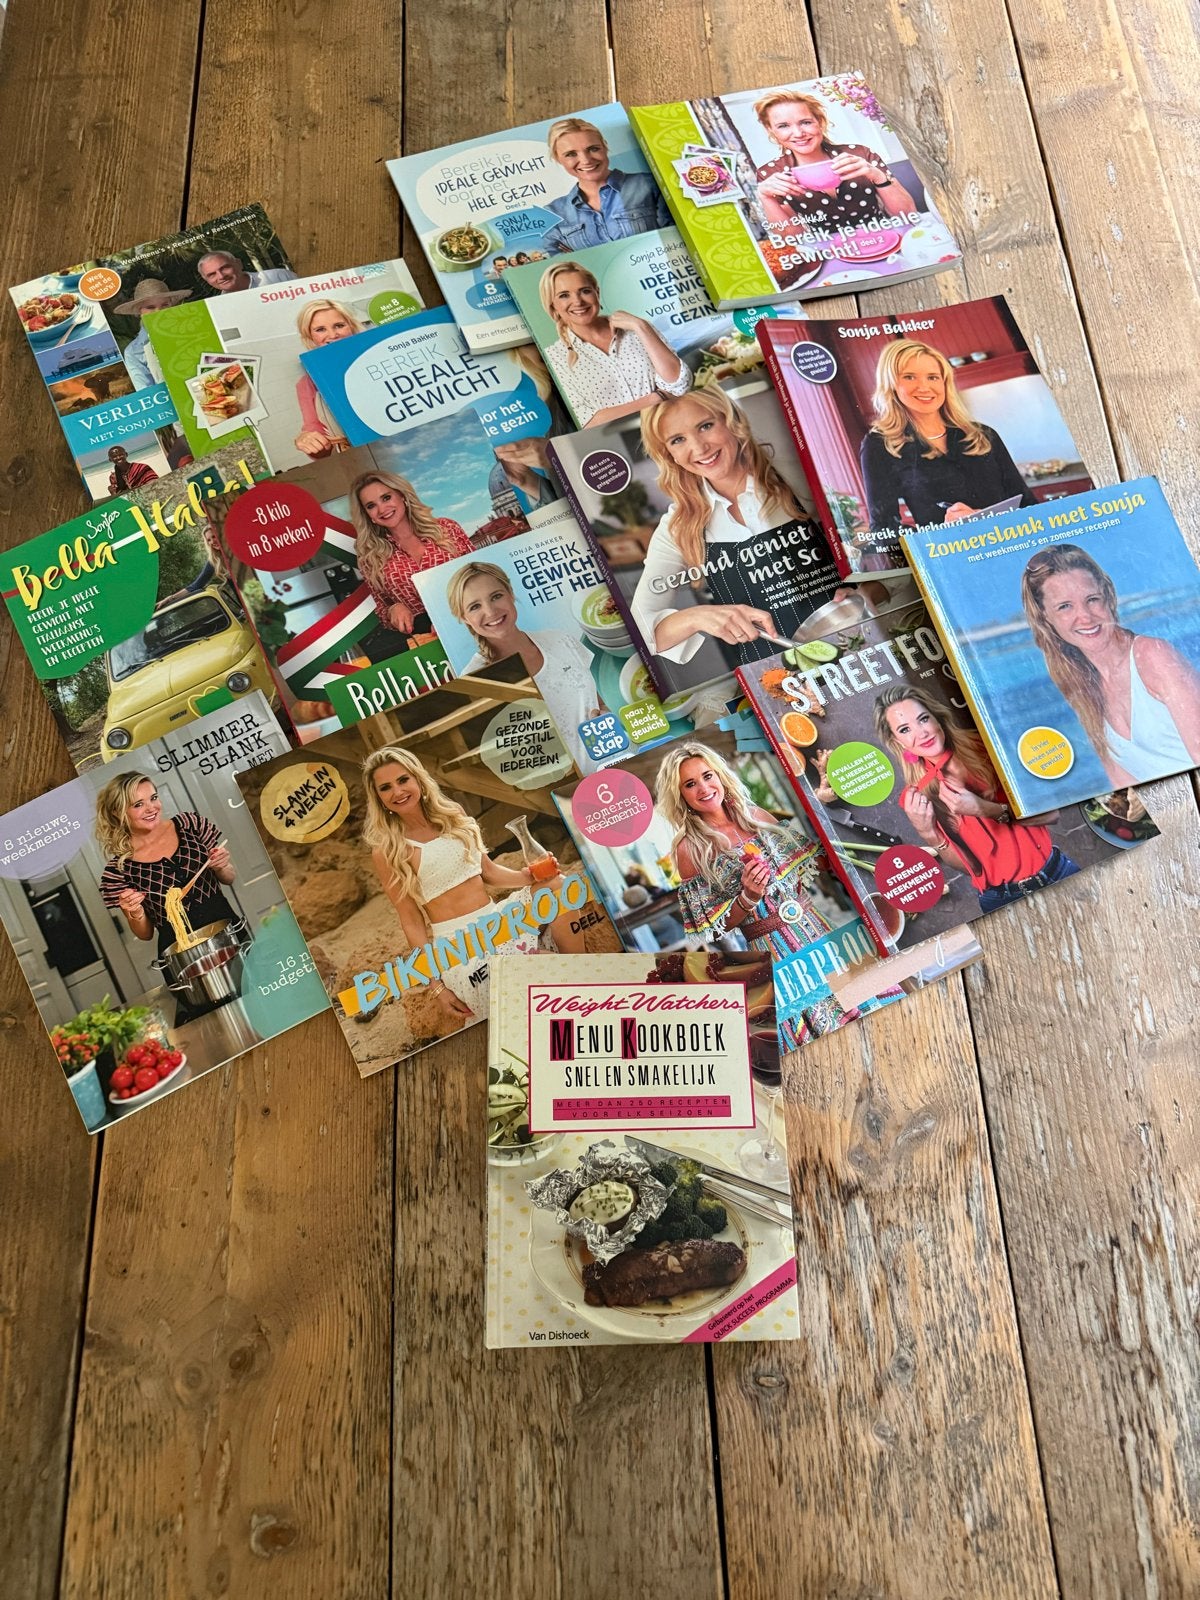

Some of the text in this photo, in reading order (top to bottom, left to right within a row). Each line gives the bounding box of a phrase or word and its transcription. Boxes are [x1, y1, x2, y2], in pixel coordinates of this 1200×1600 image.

[435, 156, 546, 195] IDEALE GEWICHT
[440, 153, 512, 179] Bereik je
[438, 180, 509, 206] voor het
[468, 182, 547, 212] HELE GEZIN
[495, 213, 529, 230] SONJA
[503, 220, 546, 236] BAKKER
[761, 213, 827, 231] Sonja Bakker
[769, 211, 921, 249] Bereik je ideale
[120, 213, 256, 266] Weekmenu's Recepten Reisverhalen
[630, 251, 655, 267] Sonja
[649, 255, 691, 274] Bereik
[779, 236, 884, 270] gewicht! deel 2
[260, 275, 366, 303] Sonja Bakker
[485, 283, 497, 295] 8
[640, 264, 697, 290] IDEALE
[384, 305, 405, 316] nieuwe
[391, 298, 400, 306] 8
[646, 301, 676, 317] voor
[679, 293, 702, 307] het
[670, 303, 717, 325] GEZIN
[838, 319, 935, 339] Sonja Bakker
[387, 340, 410, 353] Sonja
[411, 330, 439, 344] Bakker
[366, 344, 445, 381] BEREIK
[384, 352, 481, 398] IDEALE
[385, 366, 501, 423] GEWICHT
[78, 391, 169, 430] VERLEG
[499, 400, 525, 416] het
[89, 410, 174, 445] MET EN
[501, 411, 538, 433] gezin
[252, 501, 290, 525] -8 kilo
[926, 517, 1044, 558] Zomerslank
[1050, 506, 1087, 529] met
[1089, 492, 1146, 516] Sonja
[247, 519, 314, 557] in 8 weken!
[857, 525, 913, 542] Bereik én
[968, 518, 1121, 563] met weekmenu's en zomerse recepten
[509, 536, 563, 557] SONJA BAKKER
[514, 542, 581, 574] BEREIK
[648, 525, 812, 594] Gezond geniet
[749, 557, 796, 584] met
[12, 536, 118, 611] Bella
[521, 555, 594, 589] GEWICH
[776, 579, 791, 589] circa
[796, 573, 810, 582] kilo
[810, 569, 821, 577] per
[528, 571, 606, 607] HET HEL
[769, 586, 799, 601] meer dan
[779, 593, 808, 607] heerlijke
[27, 585, 100, 623] BEREIK JE IDEALE
[32, 600, 94, 634] GEWICHT MET
[36, 618, 86, 645] ITALIAANSE
[41, 624, 100, 655] WEEKMENU'S
[45, 635, 104, 667] EN RECEPTEN
[782, 627, 946, 713] STREETFO
[920, 668, 936, 680] MET
[346, 668, 420, 719] Bella
[509, 710, 532, 722] EEN
[625, 703, 655, 719] naar je
[630, 713, 658, 728] ideale
[496, 719, 550, 737] GEZONDE
[582, 716, 615, 736] stap
[601, 731, 615, 739] voor
[632, 718, 666, 740] gewicht
[158, 713, 259, 773] SLIMMER
[496, 731, 555, 749] LEEFSTIJL
[511, 745, 545, 758] VOOR
[593, 736, 623, 757] stap
[198, 730, 269, 775] SLANK
[247, 748, 274, 768] MET
[500, 753, 560, 773] IEDEREEN!
[832, 751, 877, 778] AFVALLEN MET
[845, 759, 879, 779] HEERLIJKE
[876, 765, 885, 773] EN
[273, 779, 316, 820] SLANK
[314, 766, 329, 783] IN
[285, 778, 336, 828] 4 WEKEN
[597, 784, 613, 804] 6
[585, 802, 647, 834] weekmenu's
[586, 795, 638, 823] zomerse
[0, 821, 80, 865] weekmenu's
[4, 814, 68, 850] 8 nieuwe
[886, 862, 926, 886] STRENGE
[893, 857, 904, 868] 8
[884, 867, 940, 899] WEEKMENU'S
[900, 881, 936, 904] MET PIT!
[570, 911, 605, 935] DEEL
[277, 956, 296, 973] 16
[533, 993, 744, 1017] Weight Watchers
[551, 1019, 726, 1060] MENU KOOKBOEK
[566, 1064, 716, 1087] SNEL EN SMAKELIJK
[708, 1293, 755, 1331] Gebaseerd op het
[713, 1277, 793, 1340] QUICK SUCCESS PROGRAMMA
[529, 1330, 590, 1340] Van Dishoeck
